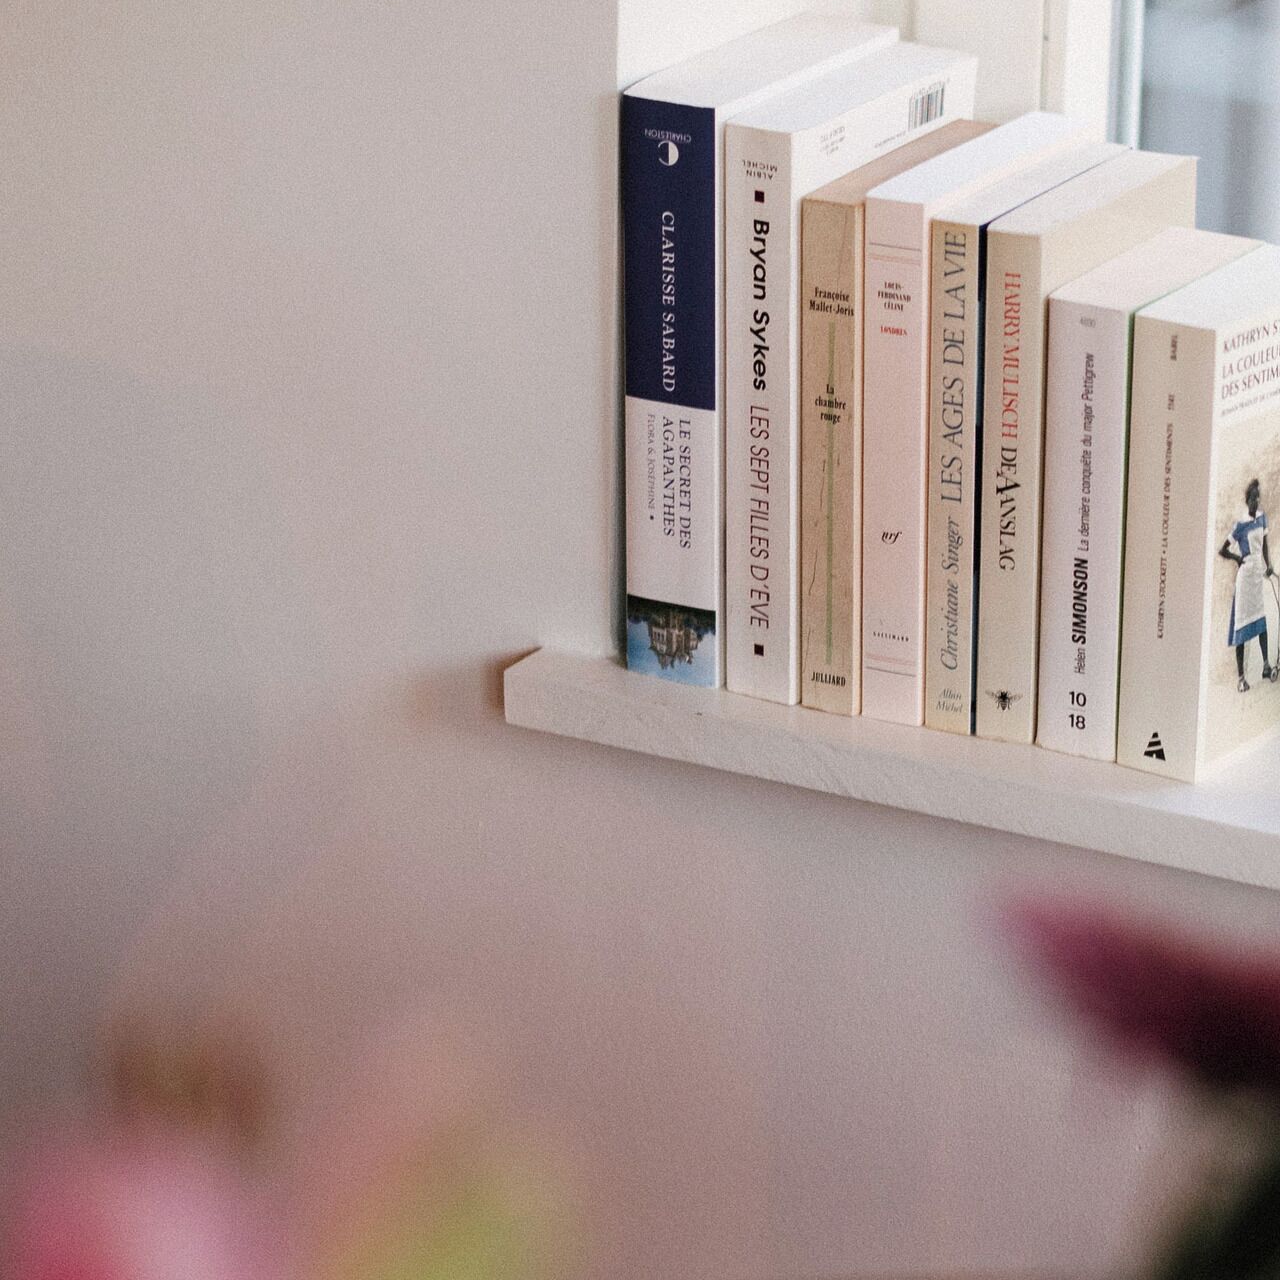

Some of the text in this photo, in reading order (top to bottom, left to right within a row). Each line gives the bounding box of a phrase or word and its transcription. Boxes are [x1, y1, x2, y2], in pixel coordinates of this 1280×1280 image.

[742, 159, 778, 173] MICHEL
[746, 169, 773, 180] ALBIN
[661, 211, 675, 392] CLARISSE SABARD
[814, 286, 850, 303] Françoise
[877, 291, 911, 303] FERDINAND
[750, 219, 769, 391] Bryan Sykes
[809, 300, 855, 317] Mallet-Joris
[884, 300, 904, 312] CÉLINE
[880, 325, 907, 337] LONDRES
[1223, 323, 1270, 352] KATHRYN
[1000, 272, 1021, 439] HARRY MULISCH
[941, 232, 966, 504] LES AGES DE LA VIE
[1222, 363, 1234, 379] LA
[1082, 353, 1096, 401] Pettigrew
[826, 384, 834, 395] La
[1221, 381, 1239, 400] DES
[814, 397, 846, 410] chambre
[750, 405, 769, 440] LES
[820, 410, 841, 424] rouge
[1083, 403, 1095, 431] major
[648, 414, 656, 444] FLORA
[1082, 431, 1092, 446] du
[648, 447, 656, 455] &
[662, 416, 675, 537] AGAPANTHES
[750, 446, 769, 494] SEPT
[679, 419, 691, 549] LE SECRET DES
[996, 446, 1021, 570] DE AANSLAG
[750, 498, 769, 560] FILLES
[881, 531, 902, 545] nrf
[1078, 539, 1089, 552] La
[940, 516, 963, 670] Christiane Singer
[1072, 558, 1088, 674] Helen SIMONSON
[811, 671, 846, 687] JULLIARD
[1069, 691, 1087, 707] 10
[1068, 714, 1086, 730] 18
